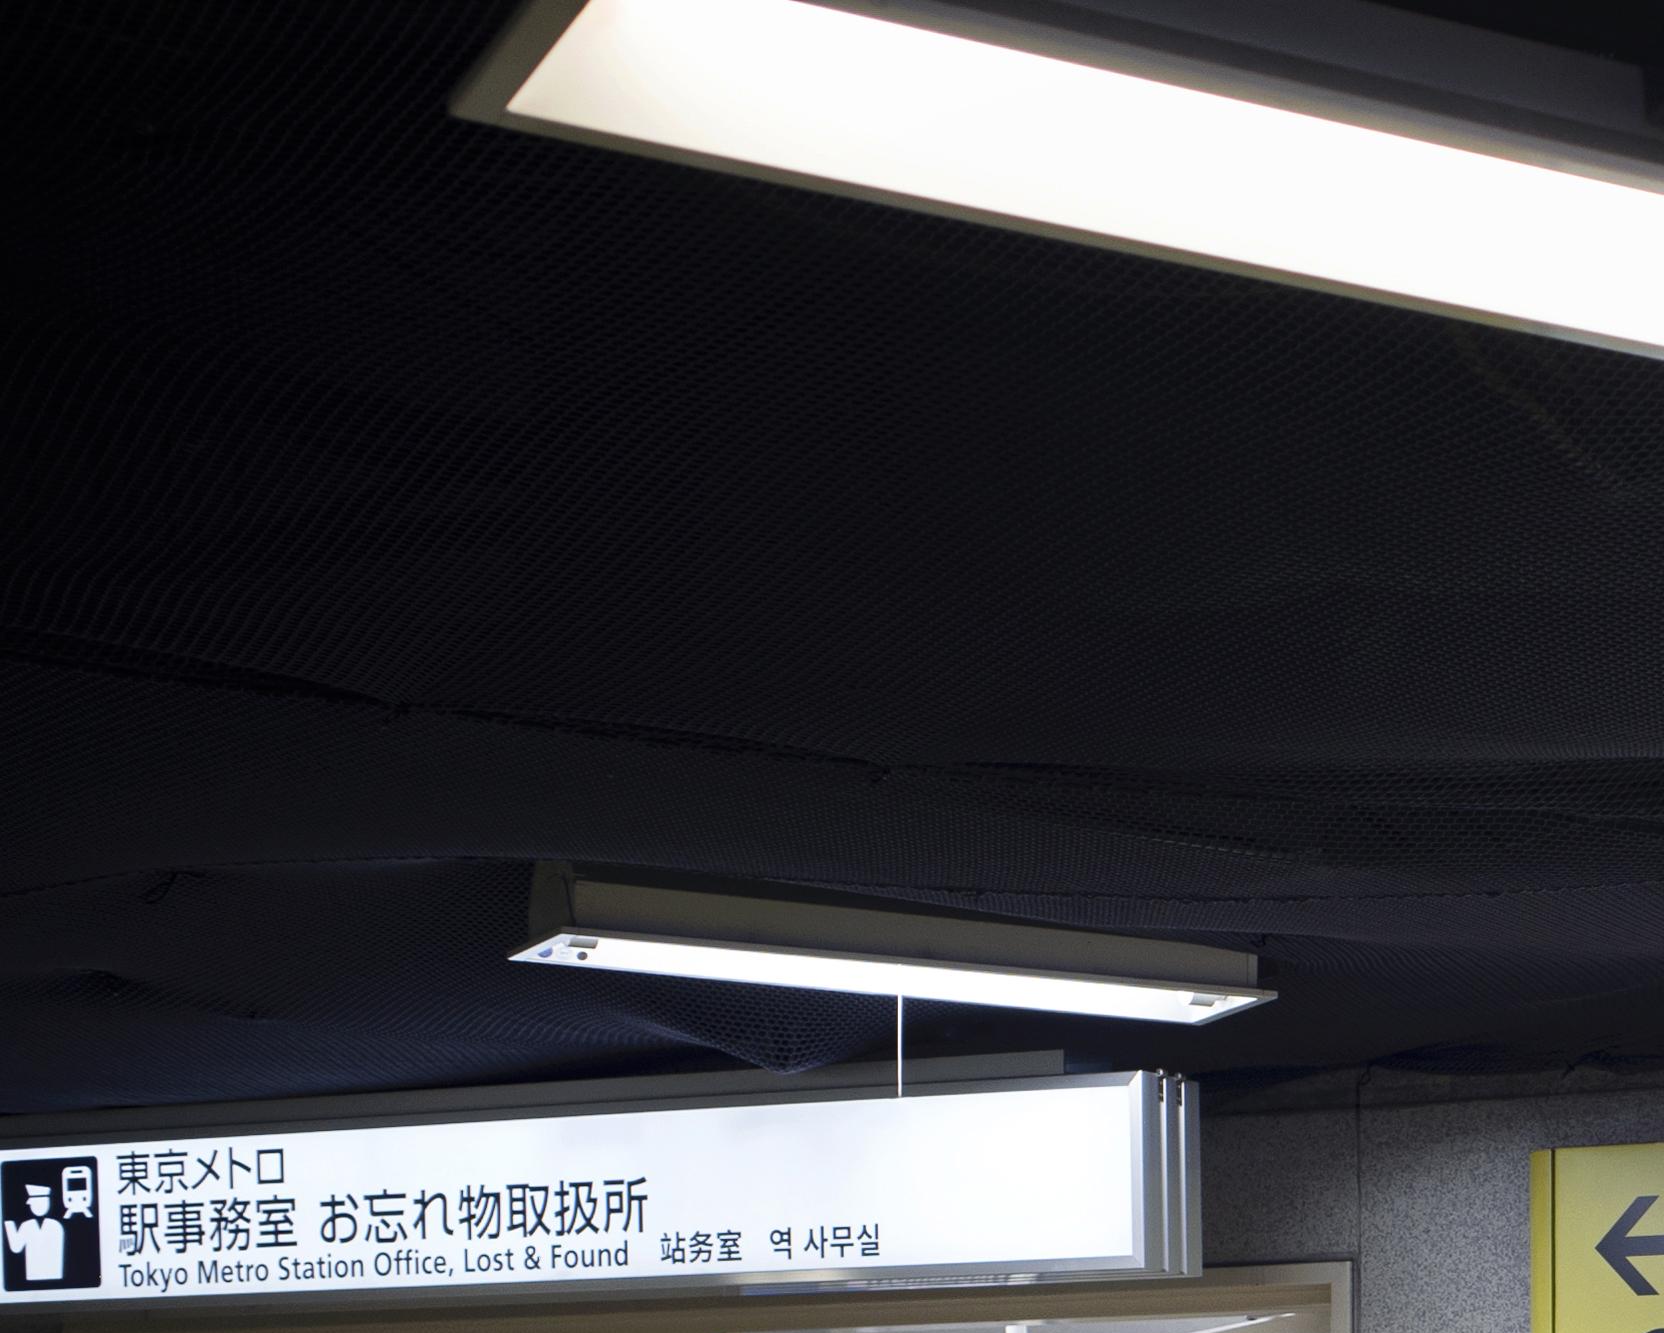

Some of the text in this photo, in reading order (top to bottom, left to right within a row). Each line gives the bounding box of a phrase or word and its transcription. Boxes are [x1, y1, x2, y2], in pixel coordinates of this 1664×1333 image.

[117, 1147, 284, 1195] 東京メトロ
[120, 1177, 648, 1256] 駅事務室 お忘れ物取扱所
[661, 1230, 742, 1264] 站务室
[770, 1224, 879, 1259] 역 사무실
[119, 1240, 628, 1293] Tokyo Metro Station Office, Lost & Found
